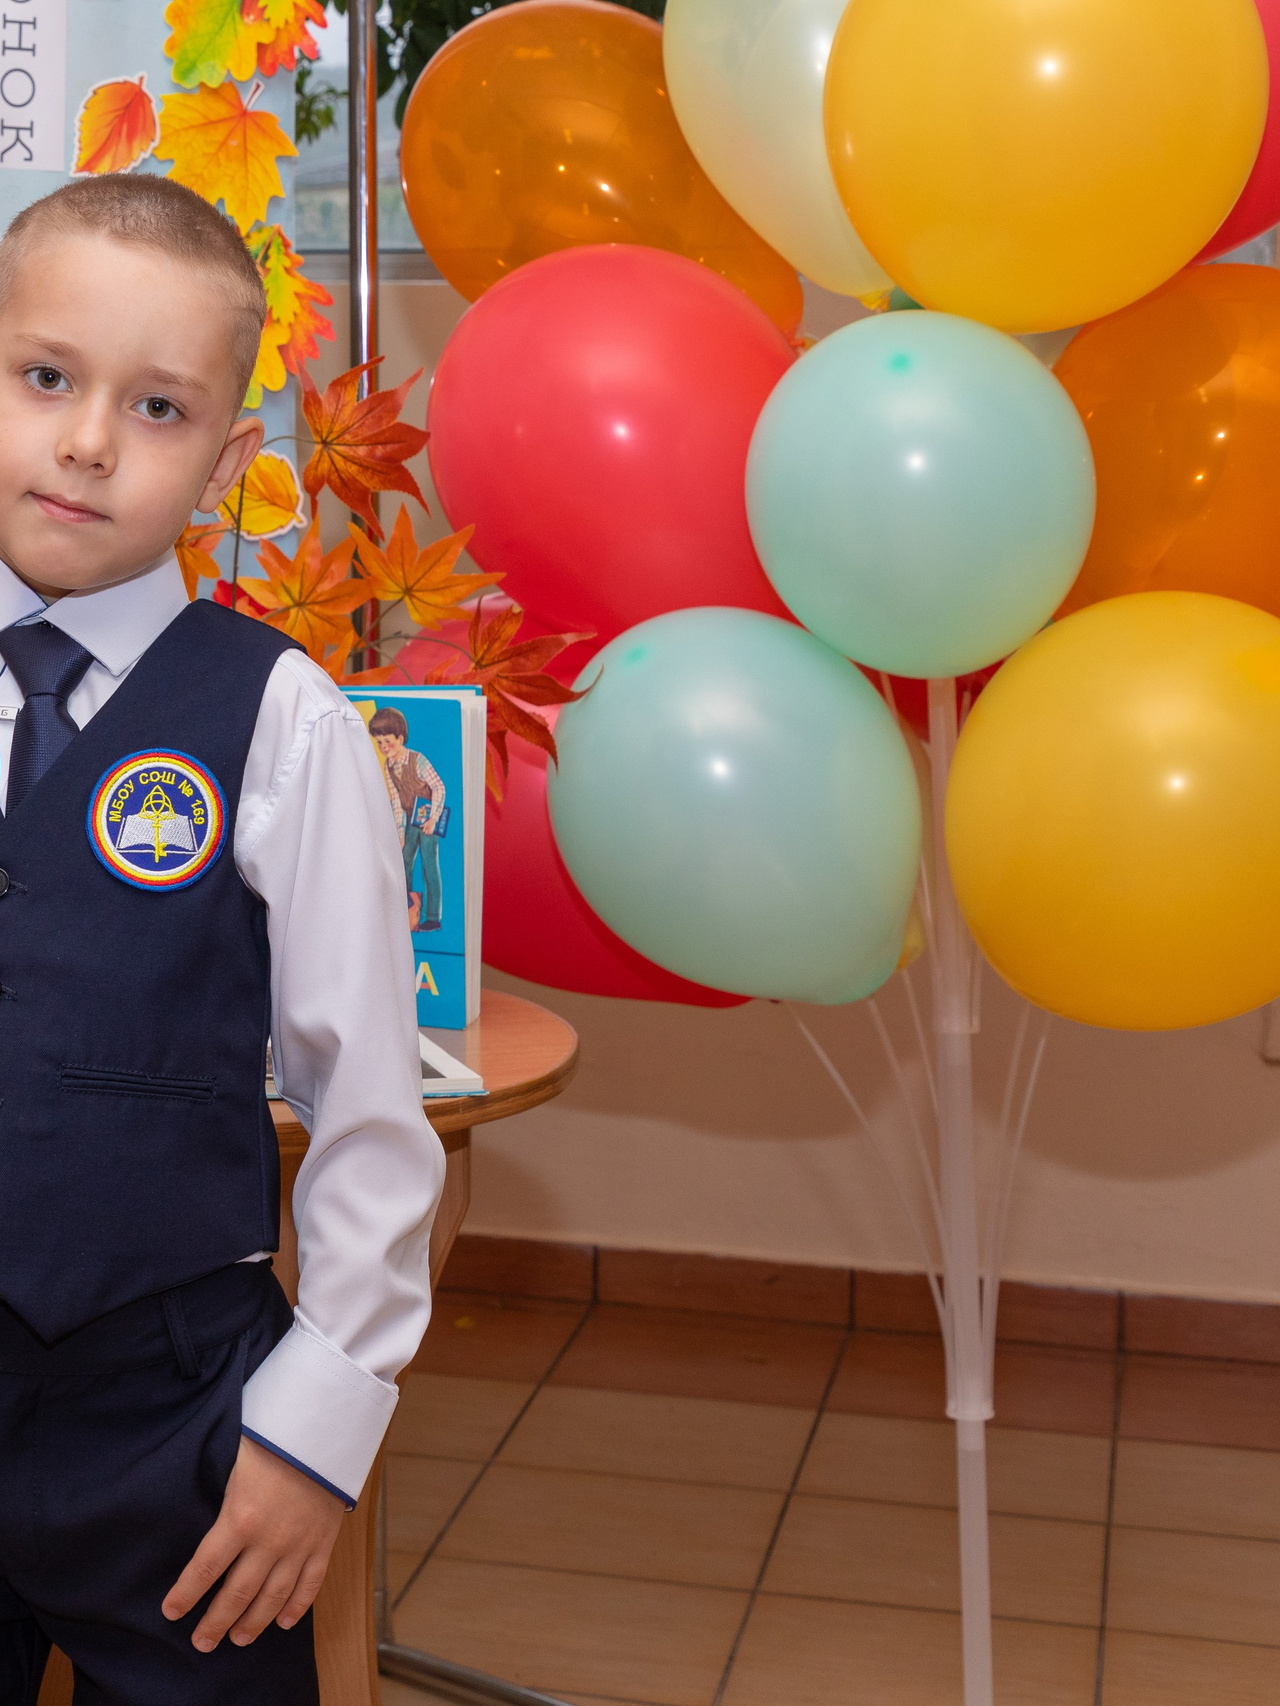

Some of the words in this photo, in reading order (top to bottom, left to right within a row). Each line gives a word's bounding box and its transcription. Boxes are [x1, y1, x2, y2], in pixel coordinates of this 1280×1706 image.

[0, 0, 36, 163] нок
[108, 780, 135, 822] МБОУ
[139, 771, 176, 785] СОШ
[178, 780, 194, 798] №
[191, 799, 205, 825] 169
